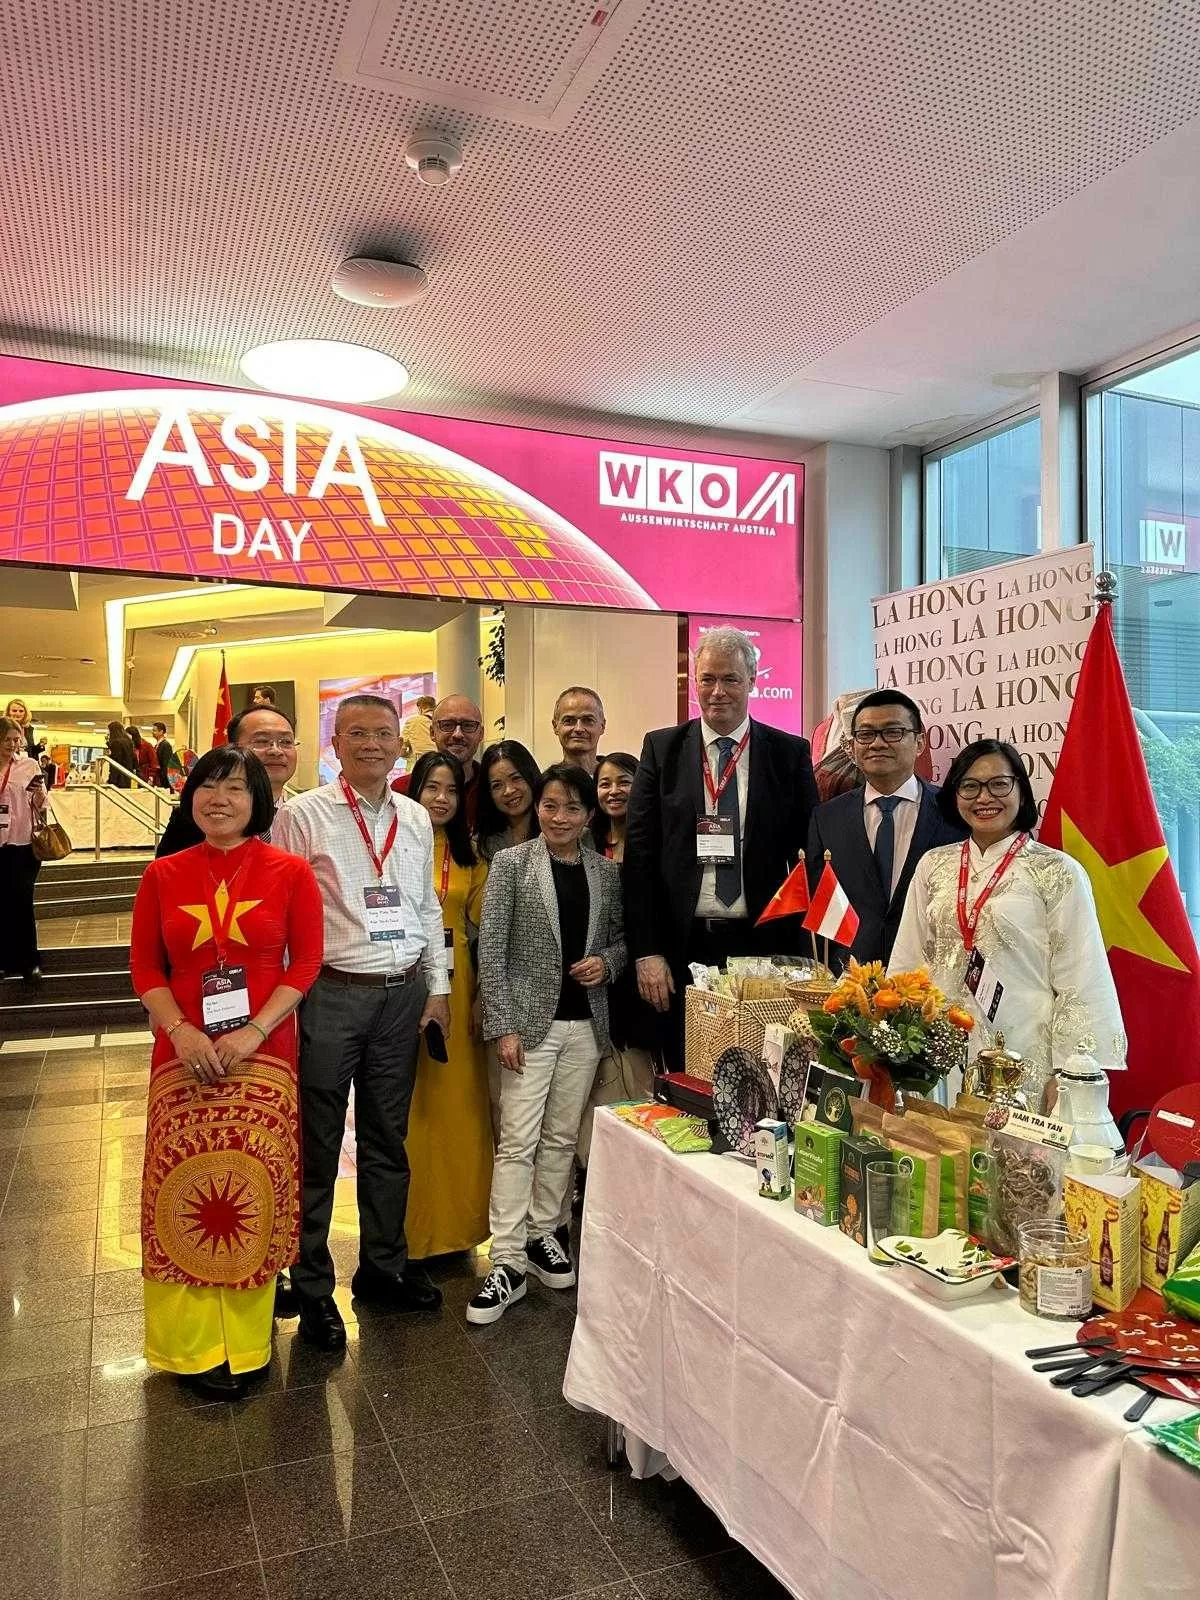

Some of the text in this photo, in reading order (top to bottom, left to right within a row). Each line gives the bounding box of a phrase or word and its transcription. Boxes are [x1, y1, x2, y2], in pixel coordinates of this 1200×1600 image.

[125, 404, 387, 527] ASIA
[605, 461, 730, 509] WKO
[213, 513, 312, 562] DAY
[620, 513, 776, 536] AUSSENWIRTSCHAFT AUSTRIA
[872, 562, 1091, 628] LA HONG LA HONG
[875, 593, 1094, 659] LA HONG LA HONG
[875, 665, 899, 690] LA
[906, 650, 987, 685] HONG
[997, 652, 1020, 672] LA
[951, 685, 986, 713] LA
[926, 721, 984, 750] ONG
[1023, 722, 1068, 743] HON
[1031, 1117, 1045, 1127] TRA
[1047, 1123, 1063, 1133] TAN
